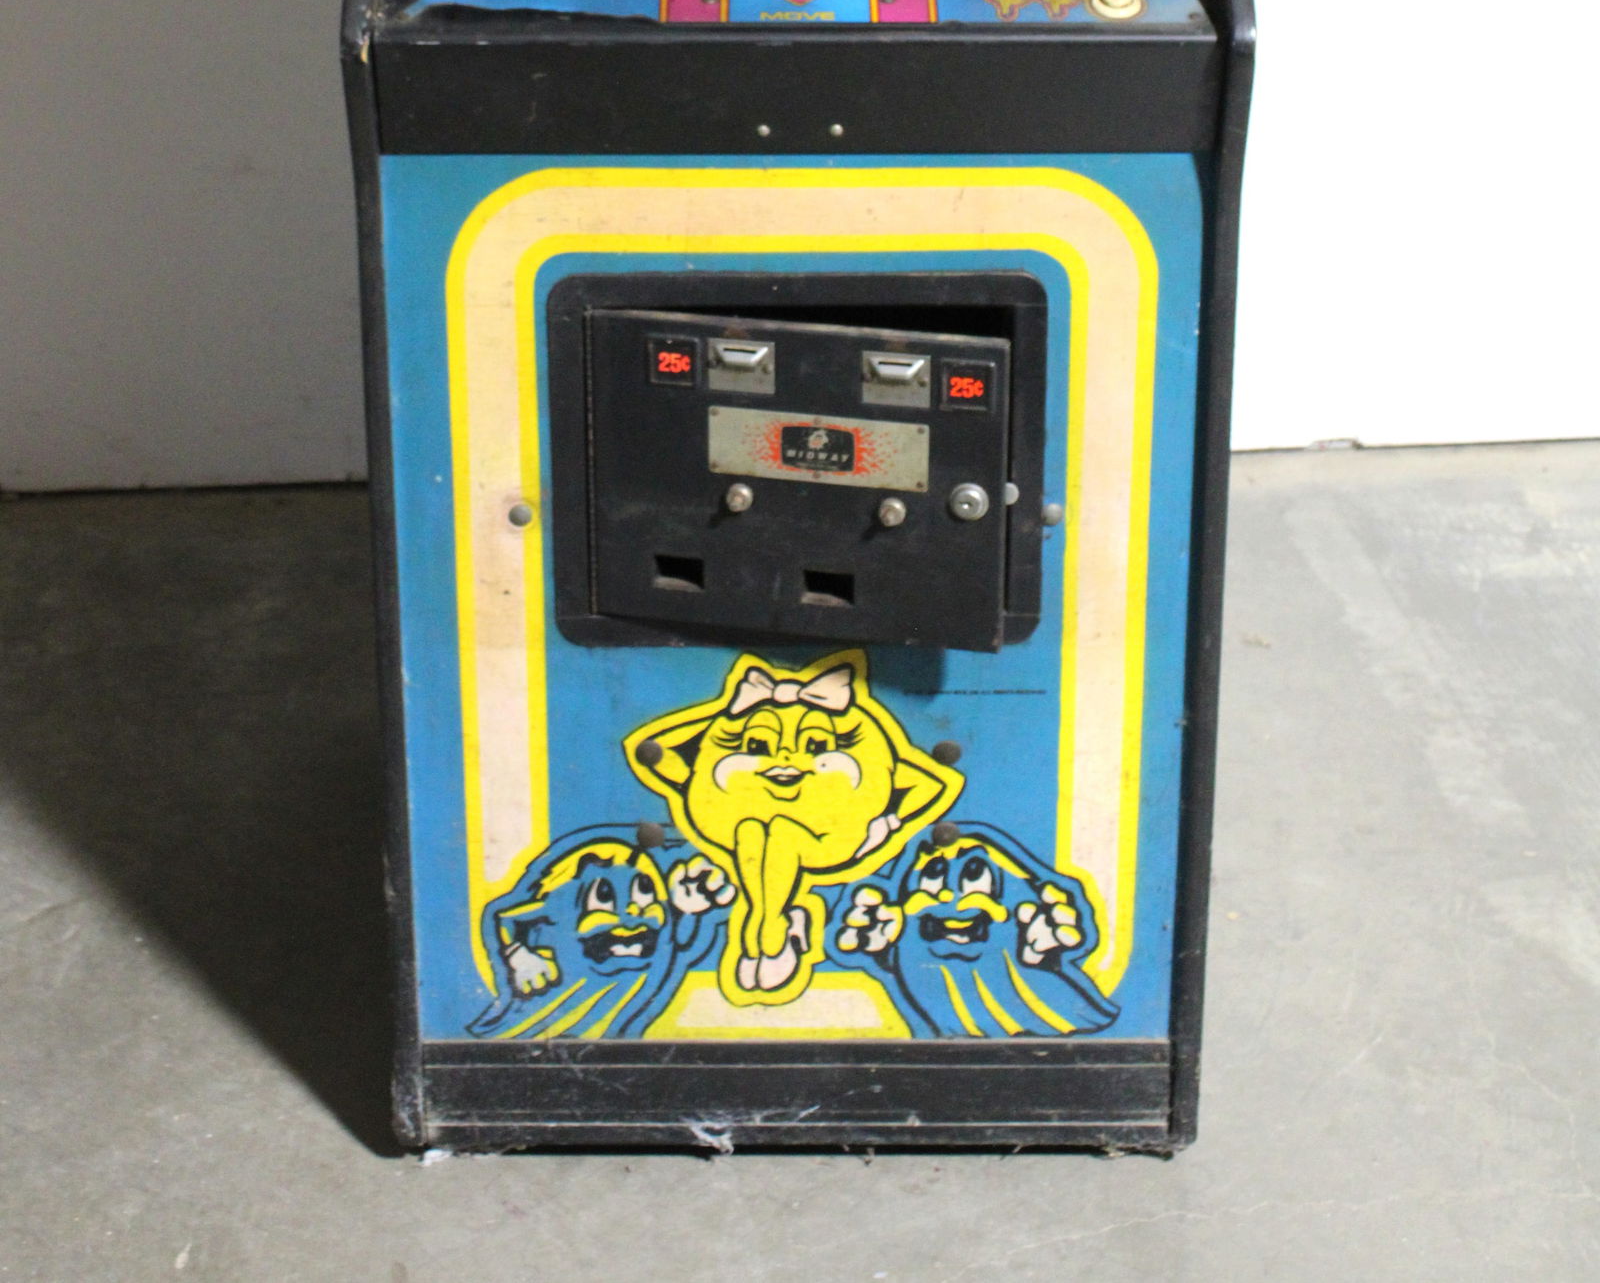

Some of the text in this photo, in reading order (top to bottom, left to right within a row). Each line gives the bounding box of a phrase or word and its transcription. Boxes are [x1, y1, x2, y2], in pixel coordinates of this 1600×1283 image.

[759, 11, 836, 22] MOVE
[658, 352, 691, 374] 25¢
[949, 377, 985, 398] 25¢
[786, 449, 850, 463] MIDWAY
